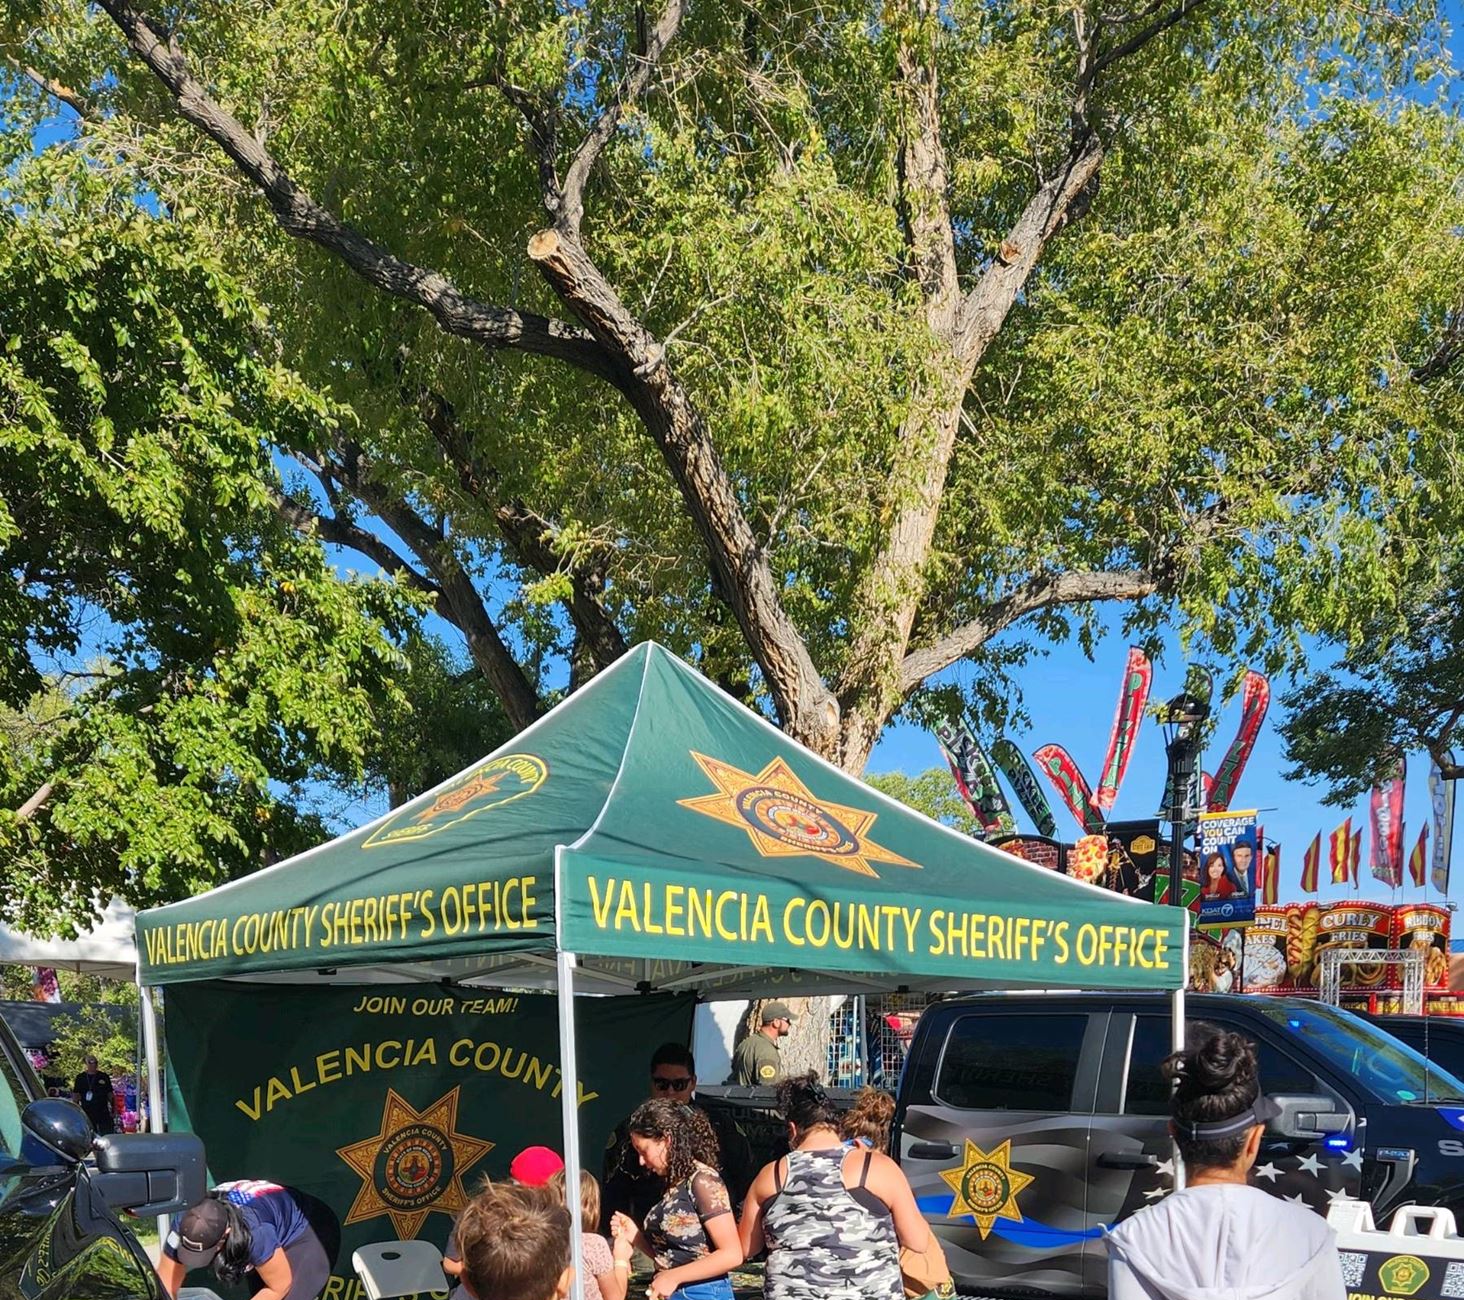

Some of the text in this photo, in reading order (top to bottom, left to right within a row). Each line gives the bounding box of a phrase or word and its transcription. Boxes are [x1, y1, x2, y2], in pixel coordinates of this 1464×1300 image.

[1203, 817, 1255, 829] COVERAGE
[1203, 826, 1246, 838] YOU CAN
[1203, 835, 1238, 846] COUNT
[1202, 845, 1218, 855] ON
[144, 876, 537, 966] VALENCIA COUNTY SHERIFF'S OFFICE
[587, 876, 1170, 970] VALENCIA COUNTY SHERIFF'S OFFICE
[1320, 912, 1379, 929] CURLY
[1405, 914, 1445, 928] RIBBON
[1329, 931, 1369, 942] FRIES
[353, 996, 519, 1015] JOIN OUR TEAM!
[235, 1038, 438, 1122] VALENCIA
[383, 1128, 448, 1154] VALENCIA COUNTY
[416, 1185, 442, 1205] OFFICE
